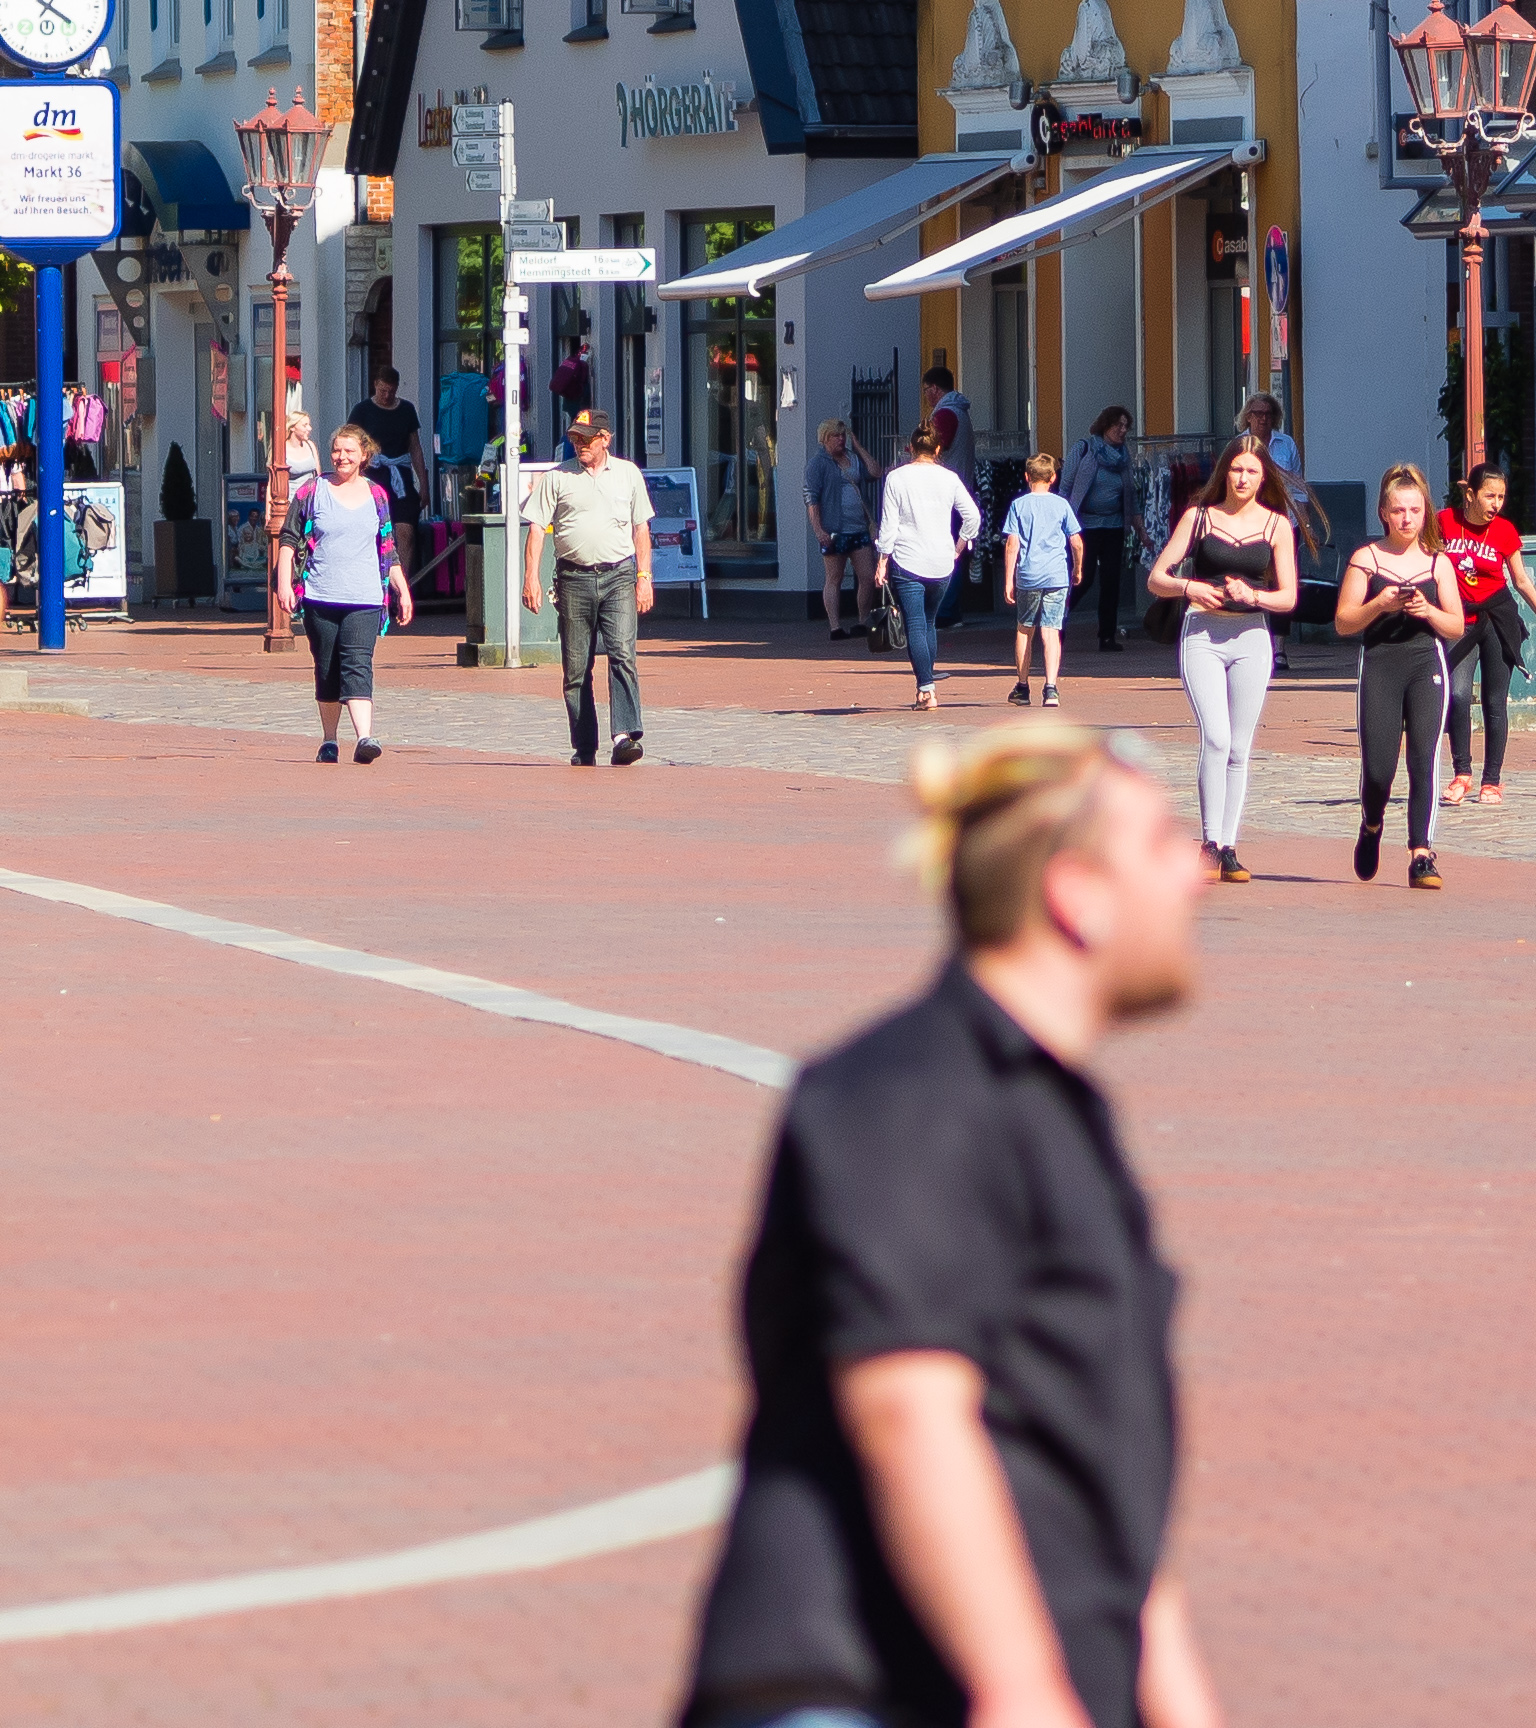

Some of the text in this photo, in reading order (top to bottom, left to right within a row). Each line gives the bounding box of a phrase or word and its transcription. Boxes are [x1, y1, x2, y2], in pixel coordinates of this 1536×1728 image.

[630, 69, 739, 140] HÖRGERÄTE
[33, 102, 76, 127] dm
[67, 151, 94, 160] markt
[24, 166, 82, 178] Markt 36
[20, 193, 86, 203] Wir freuen uns
[519, 255, 557, 266] Meldorf
[519, 267, 591, 279] Hemmingstedt
